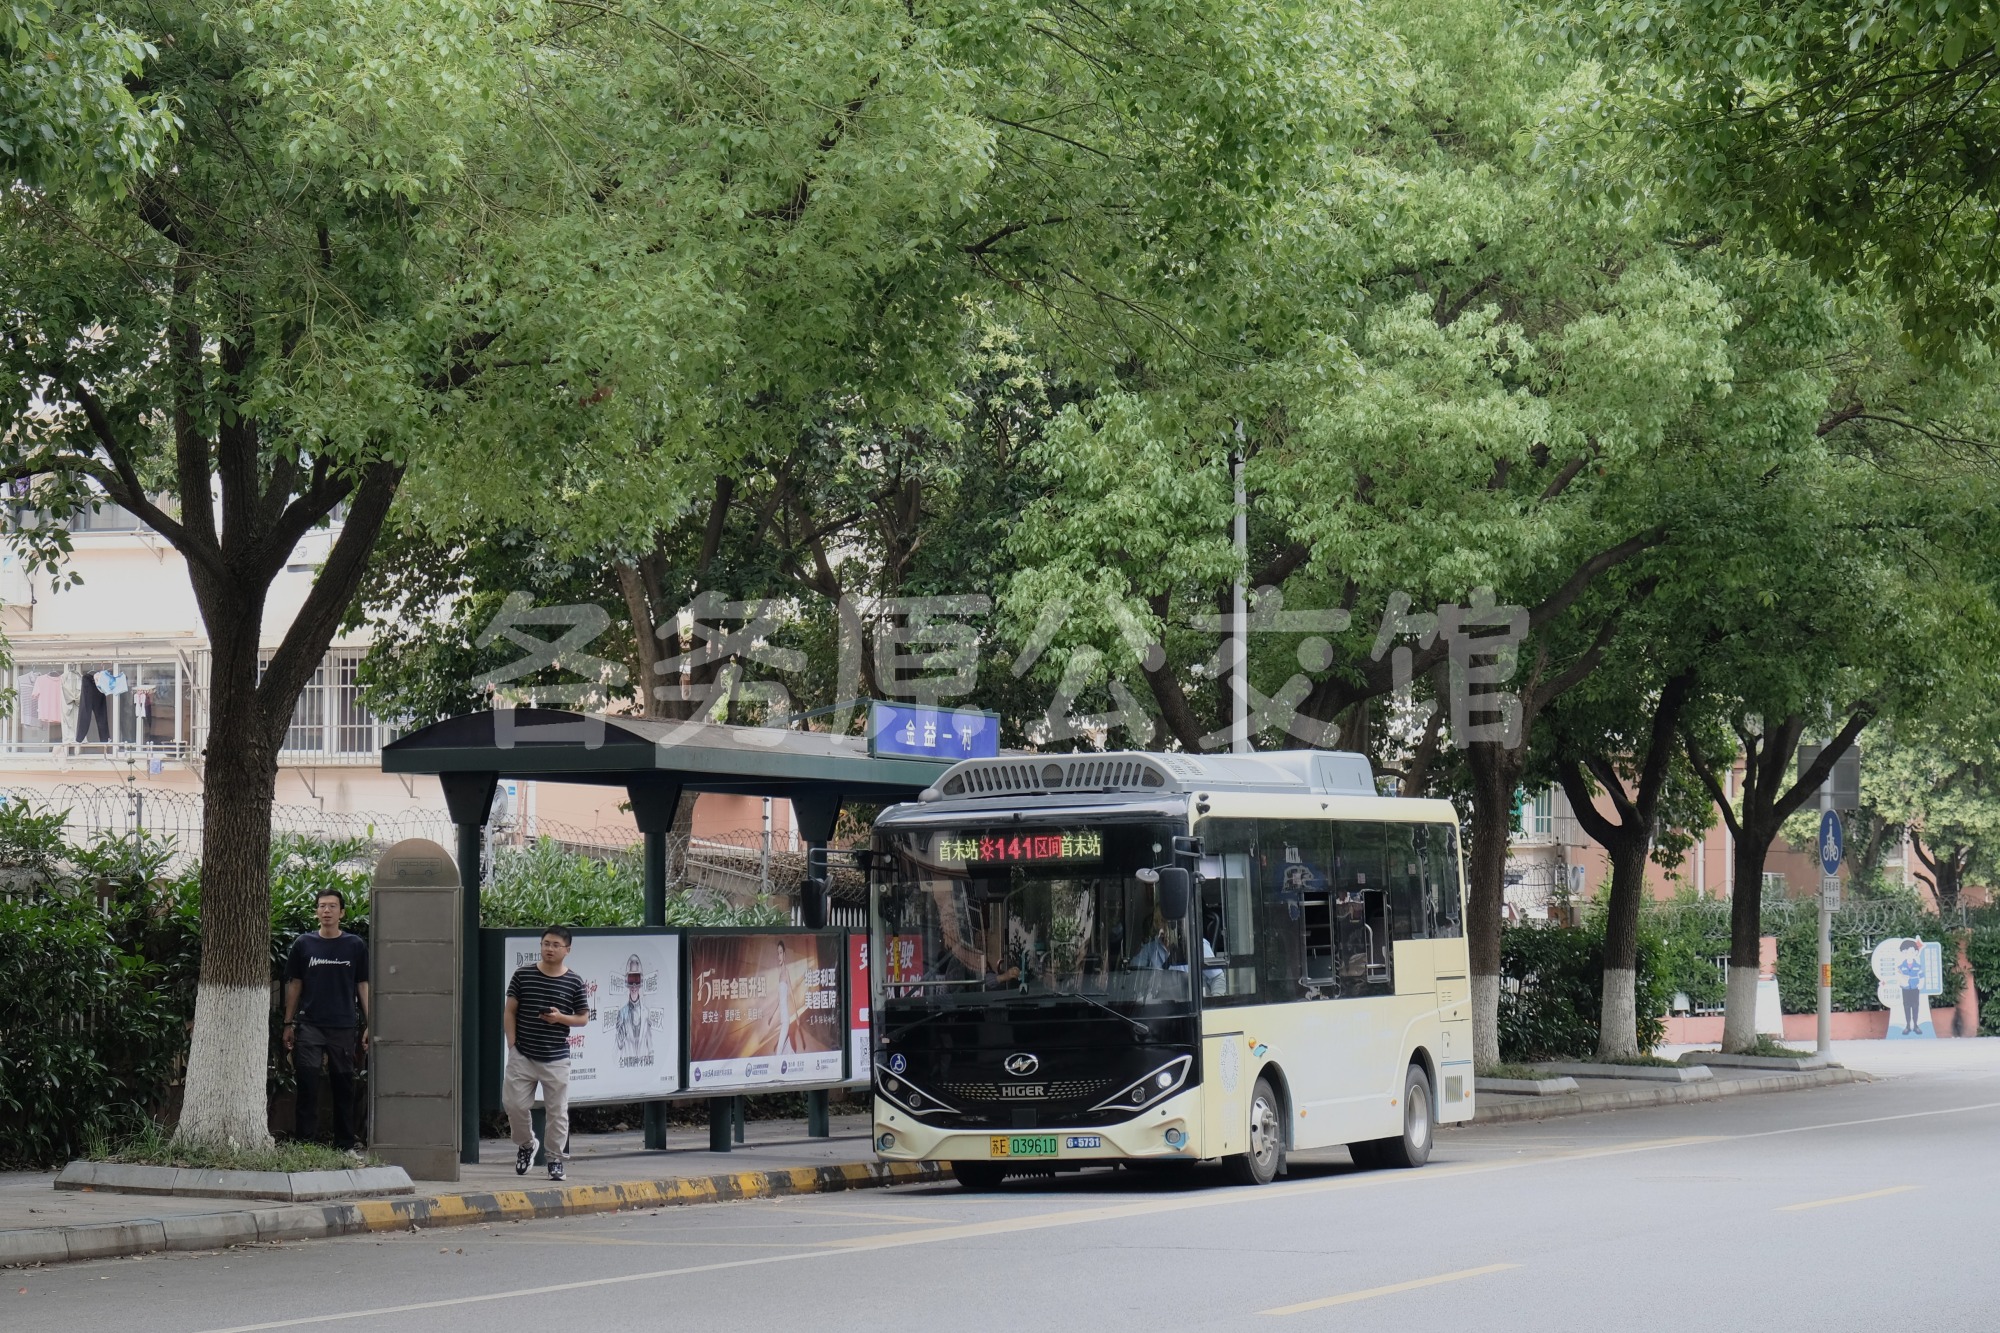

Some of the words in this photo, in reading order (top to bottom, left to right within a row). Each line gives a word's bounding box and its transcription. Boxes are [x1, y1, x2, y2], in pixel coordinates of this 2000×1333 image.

[905, 719, 972, 751] 金益一村
[939, 839, 979, 861] 首末站
[1061, 834, 1101, 857] 首末站
[804, 968, 836, 987] 维多利亚
[804, 990, 837, 1010] 美容医院
[1002, 1086, 1045, 1097] HIGER
